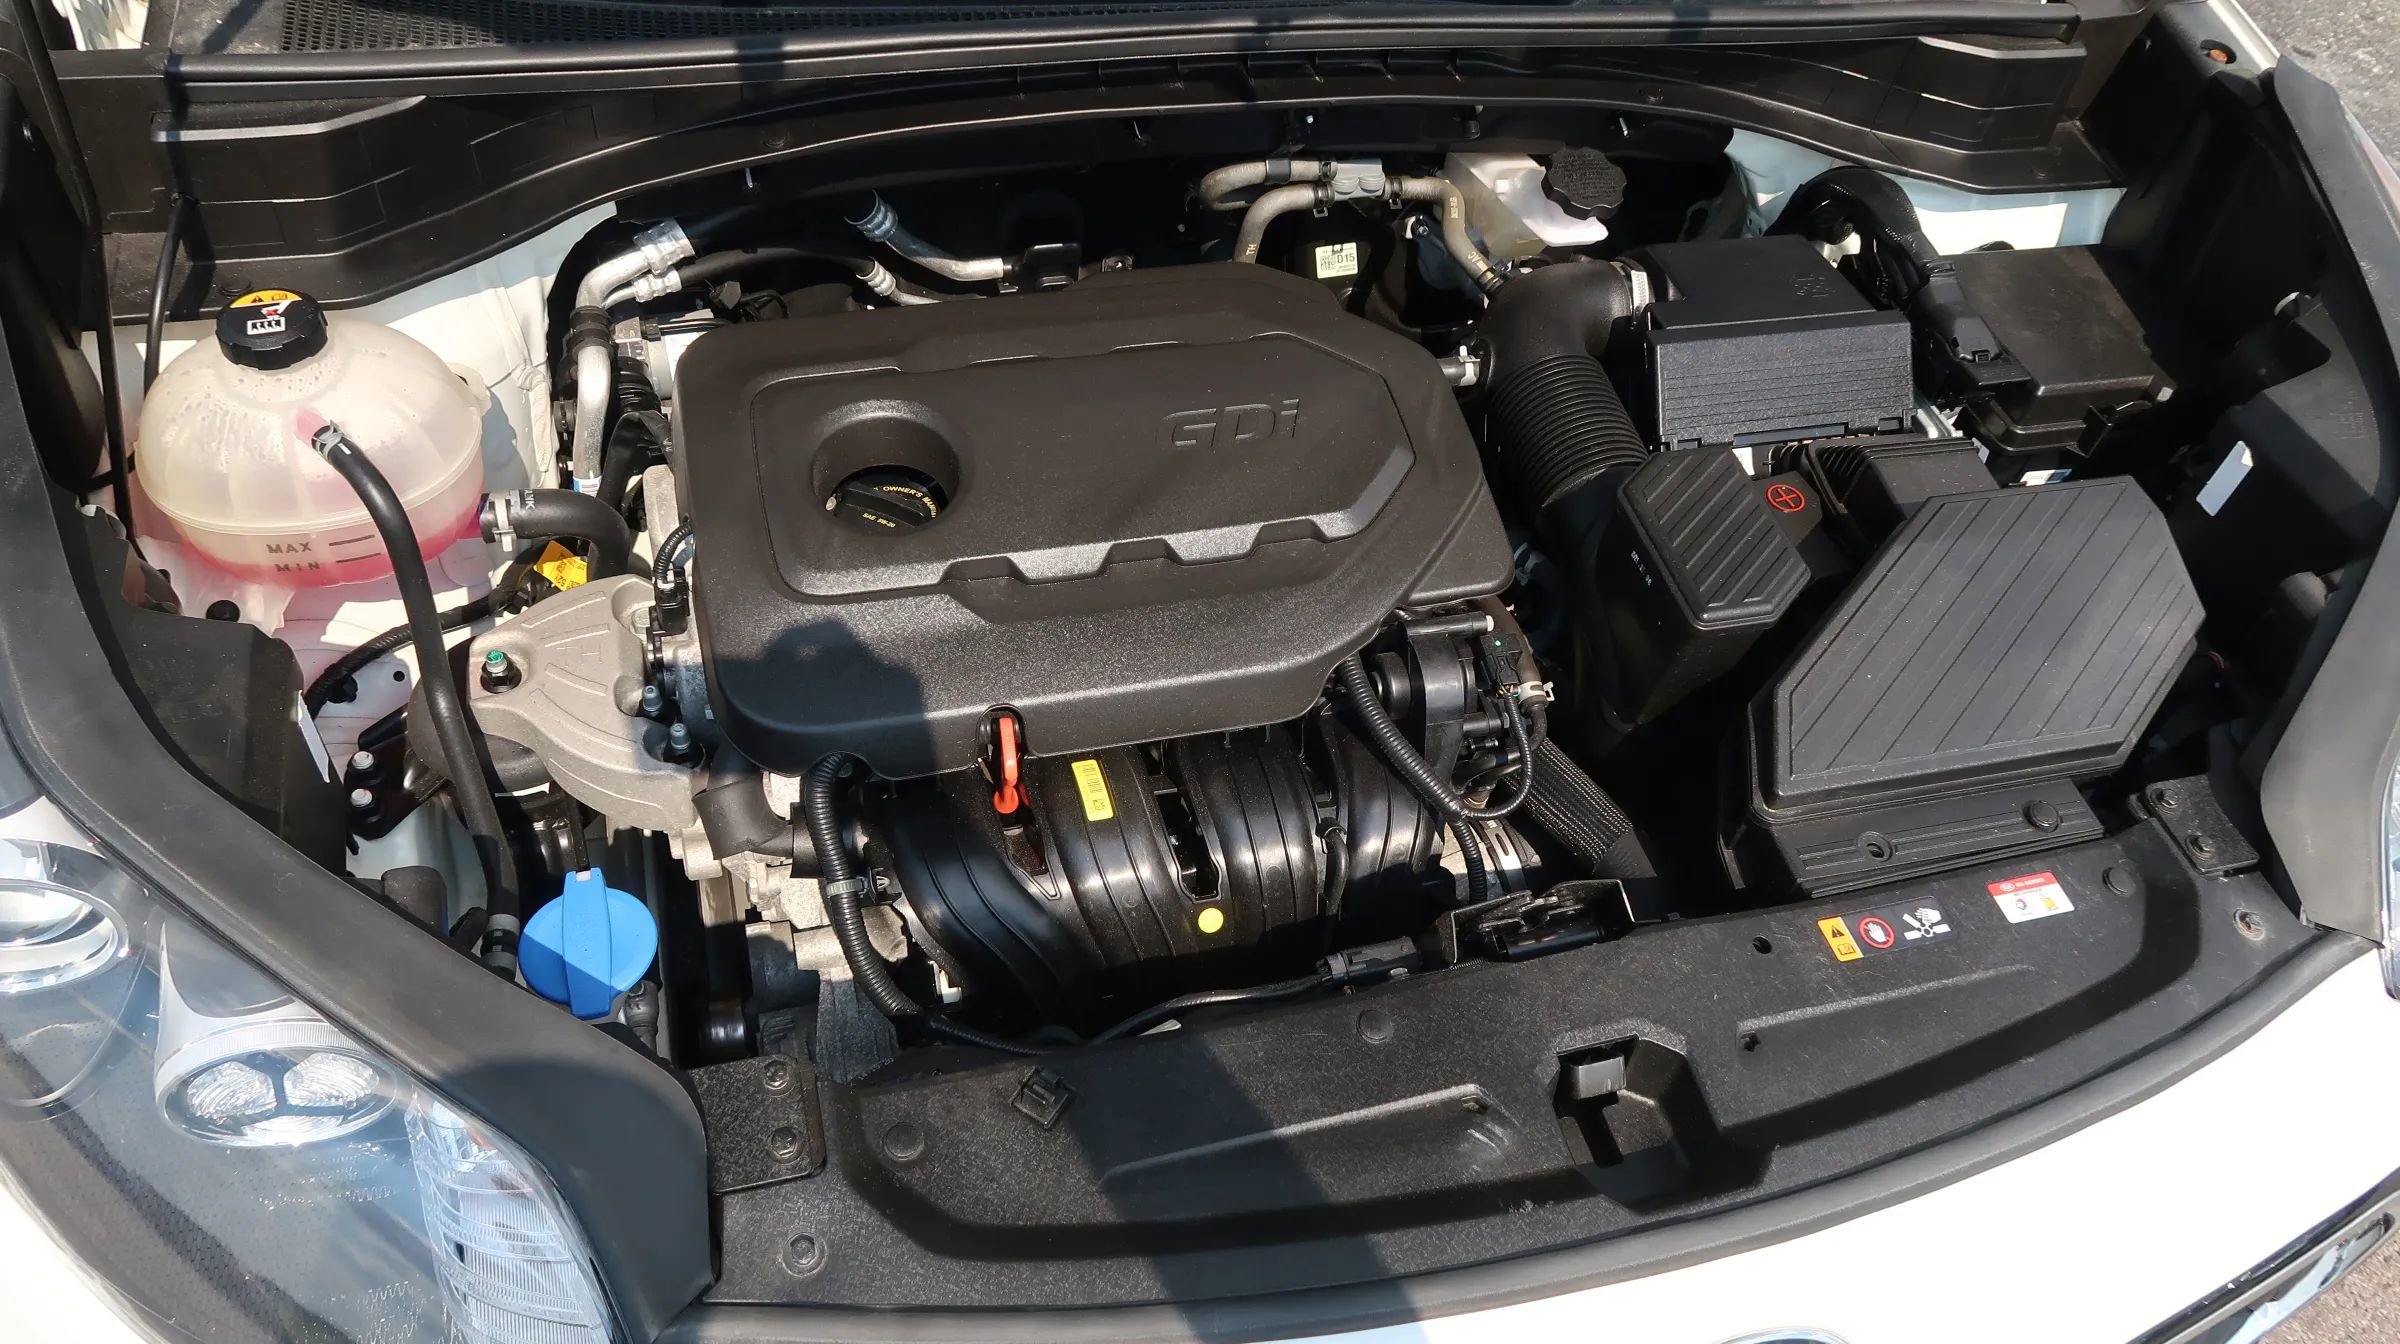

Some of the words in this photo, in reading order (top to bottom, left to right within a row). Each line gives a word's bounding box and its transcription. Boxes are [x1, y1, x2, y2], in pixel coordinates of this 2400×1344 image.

[1337, 252, 1356, 264] D15
[1154, 398, 1300, 450] GDi
[883, 485, 924, 498] OWNER'S
[862, 512, 877, 521] SAE
[266, 541, 312, 554] MAX
[274, 561, 320, 572] MIN
